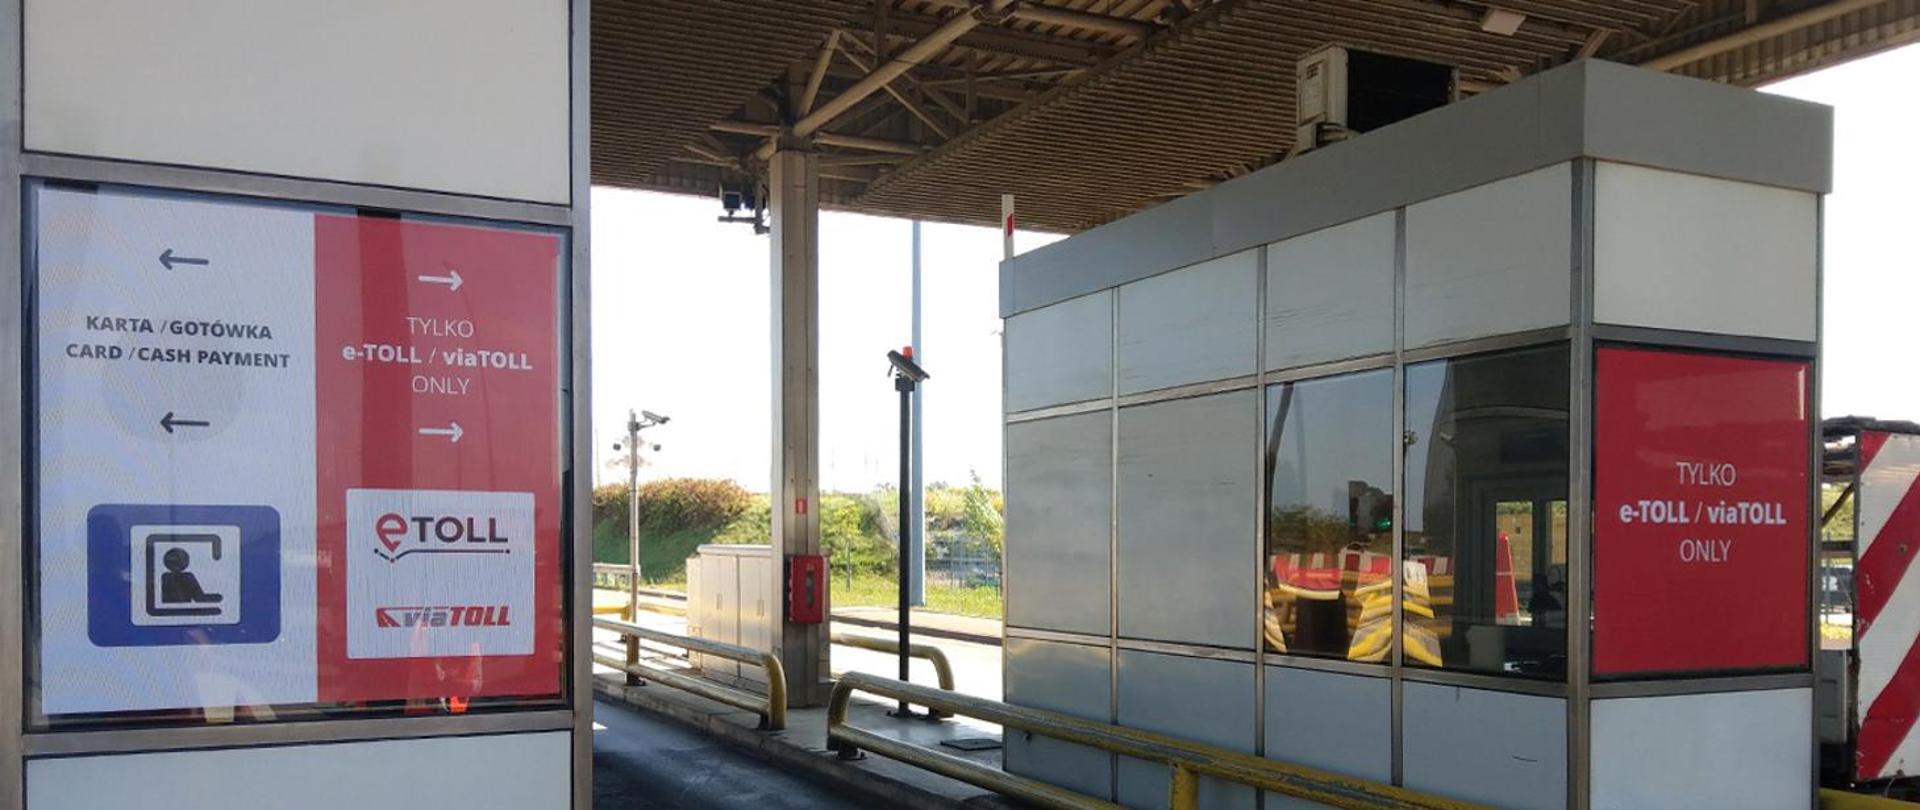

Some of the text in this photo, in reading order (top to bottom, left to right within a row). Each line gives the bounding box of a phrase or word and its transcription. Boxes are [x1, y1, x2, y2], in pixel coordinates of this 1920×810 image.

[87, 315, 153, 333] KARTA
[406, 317, 475, 338] TYLKO
[66, 343, 122, 360] CARD
[198, 350, 290, 368] PAYMENT
[342, 344, 422, 364] e-TOLL
[443, 348, 533, 370] viaTOLL
[411, 375, 470, 395] ONLY
[1676, 461, 1736, 486] TYLKO
[1619, 500, 1689, 524] e-TOLL
[1707, 501, 1786, 525] viaTOLL
[1679, 539, 1731, 562] ONLY
[404, 606, 511, 628] viaTOLL
